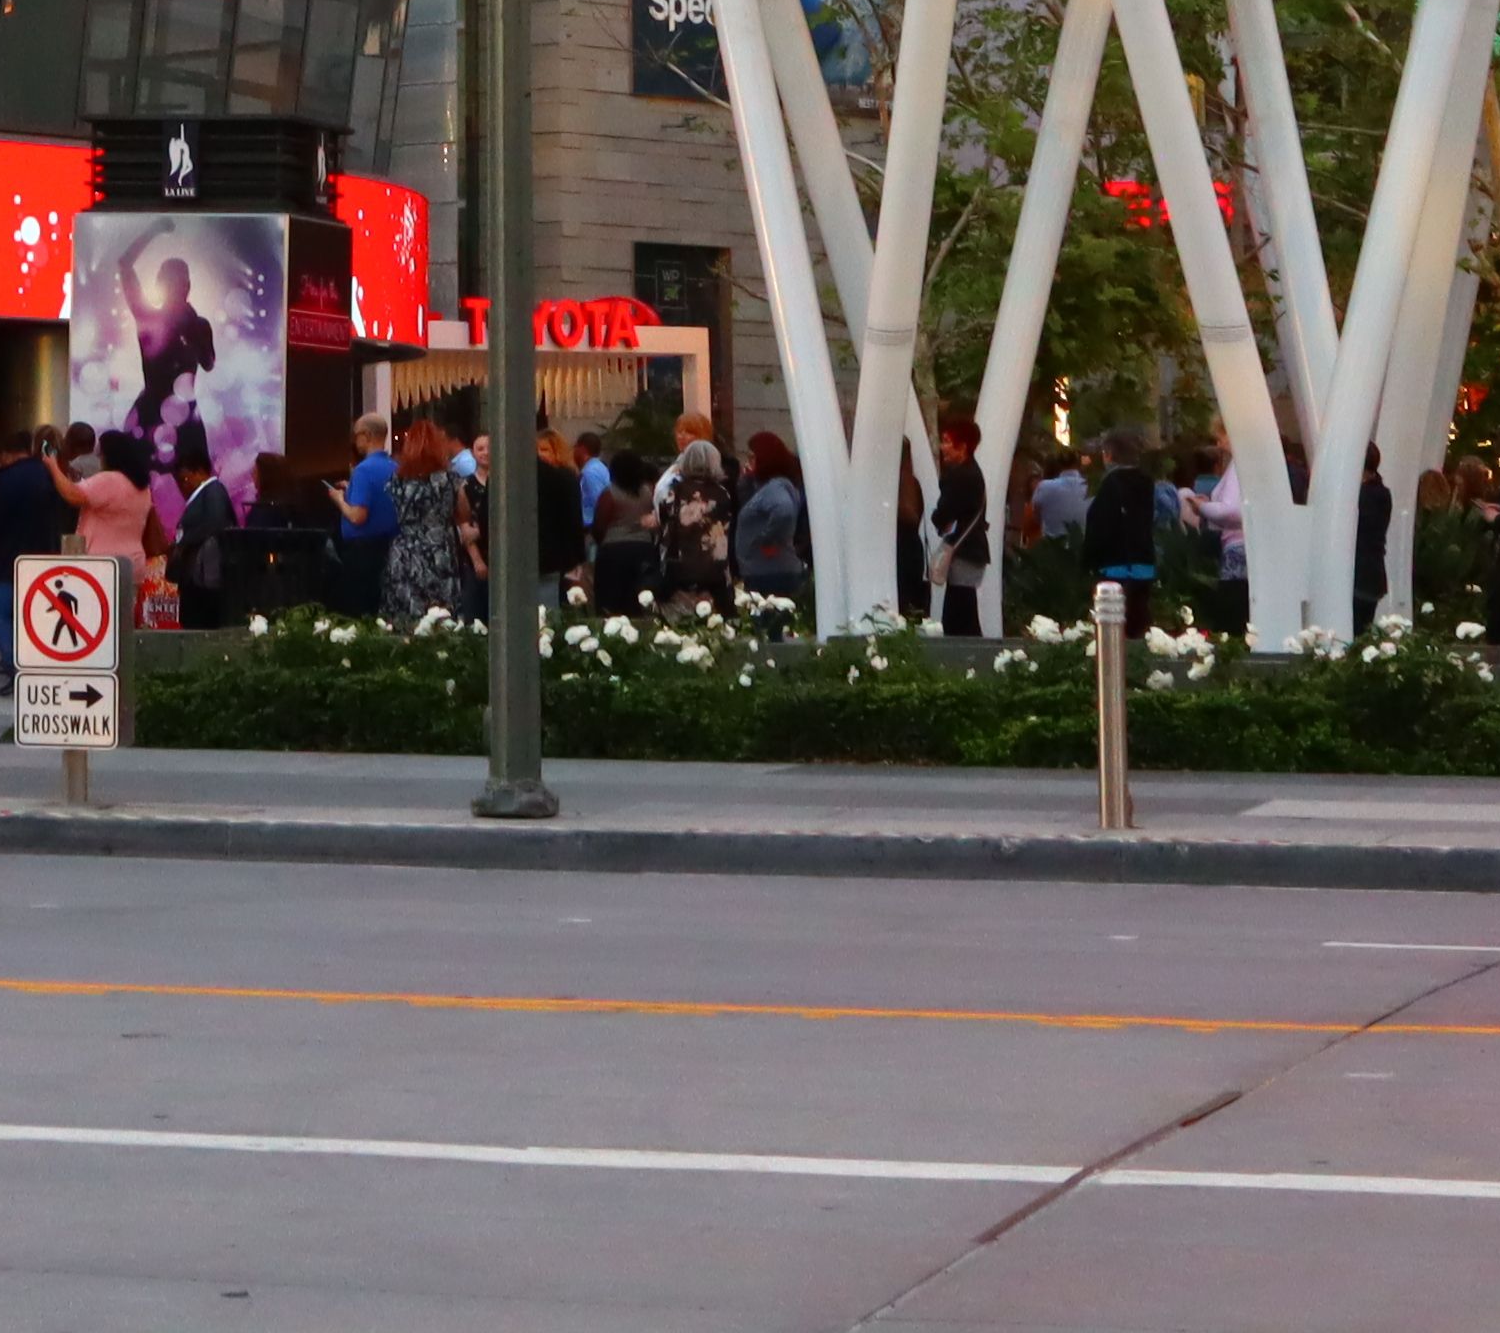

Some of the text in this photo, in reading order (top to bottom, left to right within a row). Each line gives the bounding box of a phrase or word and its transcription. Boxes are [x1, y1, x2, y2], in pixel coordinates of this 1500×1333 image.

[461, 297, 640, 349] TYOTA
[27, 684, 62, 706] USE
[21, 713, 111, 737] CROSSWALK
